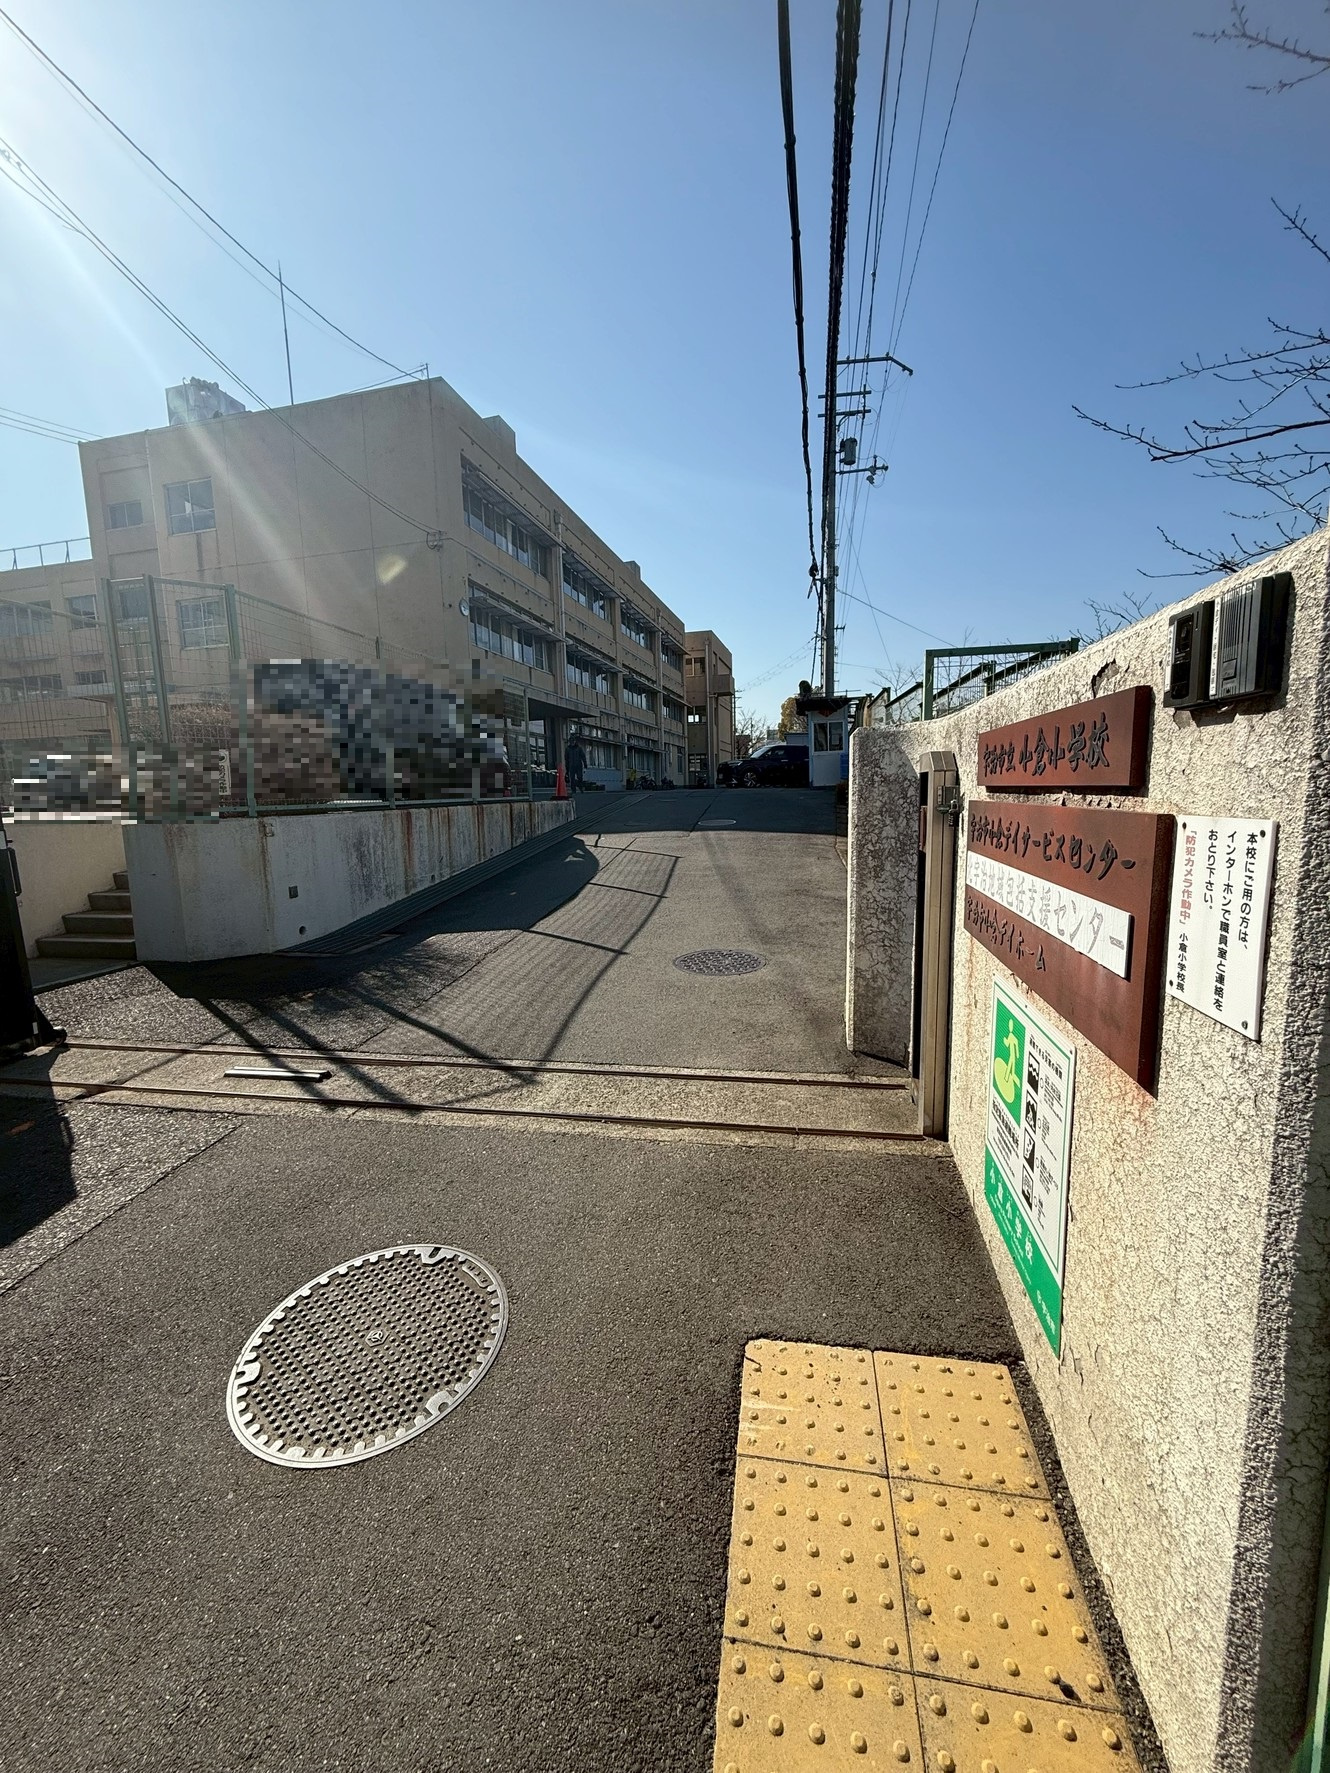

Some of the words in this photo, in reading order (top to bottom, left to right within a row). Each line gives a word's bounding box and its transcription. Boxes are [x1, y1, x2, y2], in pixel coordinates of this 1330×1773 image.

[1179, 829, 1198, 925] 「防犯カメラ作動中」
[1203, 829, 1219, 910] おとり下さい。
[1237, 832, 1258, 950] 本校にご用の方は、
[1176, 932, 1189, 994] 小倉小学校長
[1212, 830, 1238, 1012] インターホンで職員室と連絡を
